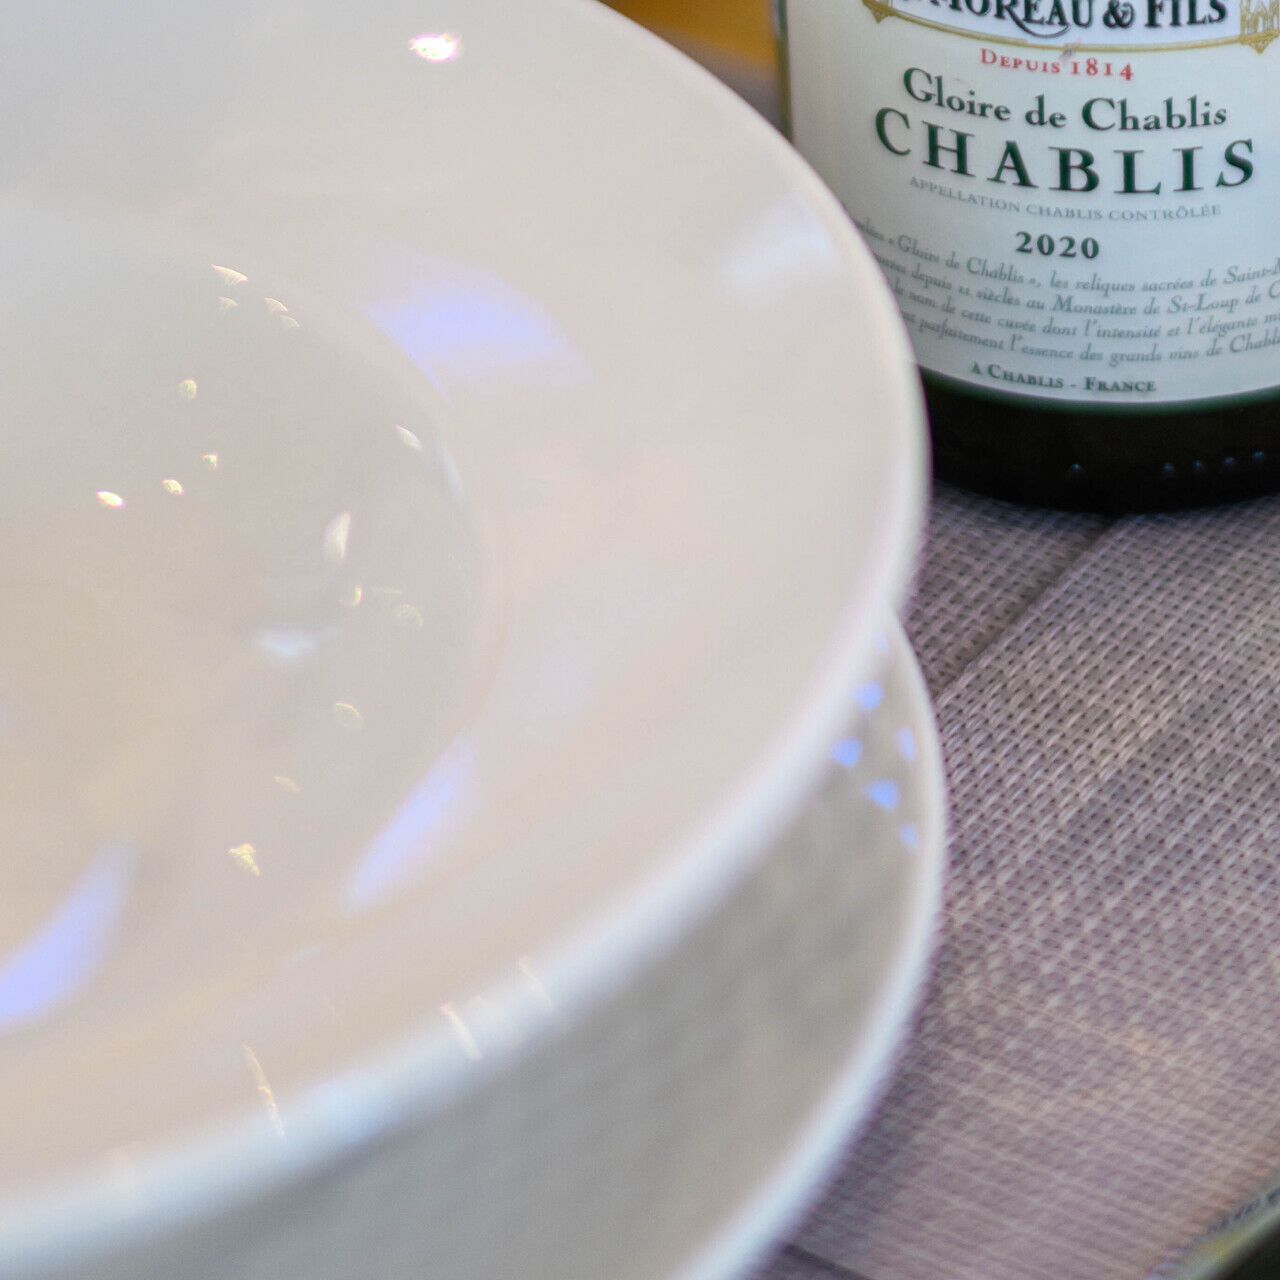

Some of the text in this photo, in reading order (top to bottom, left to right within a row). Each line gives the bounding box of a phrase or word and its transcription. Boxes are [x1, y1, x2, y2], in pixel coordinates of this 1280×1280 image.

[980, 47, 1135, 81] DEPUIS 1814
[903, 66, 1228, 131] Gloire de Chablis
[874, 106, 1256, 196] CHABLIS
[909, 176, 1222, 221] APPELLATION CHABLIS CONTRÔLÉE
[1015, 231, 1100, 259] 2020
[897, 234, 941, 263] Gloire
[945, 251, 961, 270] de
[966, 256, 1025, 284] Chablis
[1050, 270, 1069, 288] les
[1076, 272, 1136, 296] reliques
[1140, 273, 1193, 292] sacrées
[1201, 268, 1217, 287] de
[941, 296, 956, 315] de
[976, 286, 1021, 307] siècles
[1026, 299, 1045, 311] au
[1052, 293, 1137, 315] Monastère
[1143, 296, 1160, 315] de
[1245, 290, 1262, 306] de
[1080, 343, 1104, 362] des
[1109, 343, 1163, 368] grands
[1206, 339, 1224, 358] de
[987, 363, 1065, 389] CHABLIS
[1084, 375, 1157, 393] FRANCE
